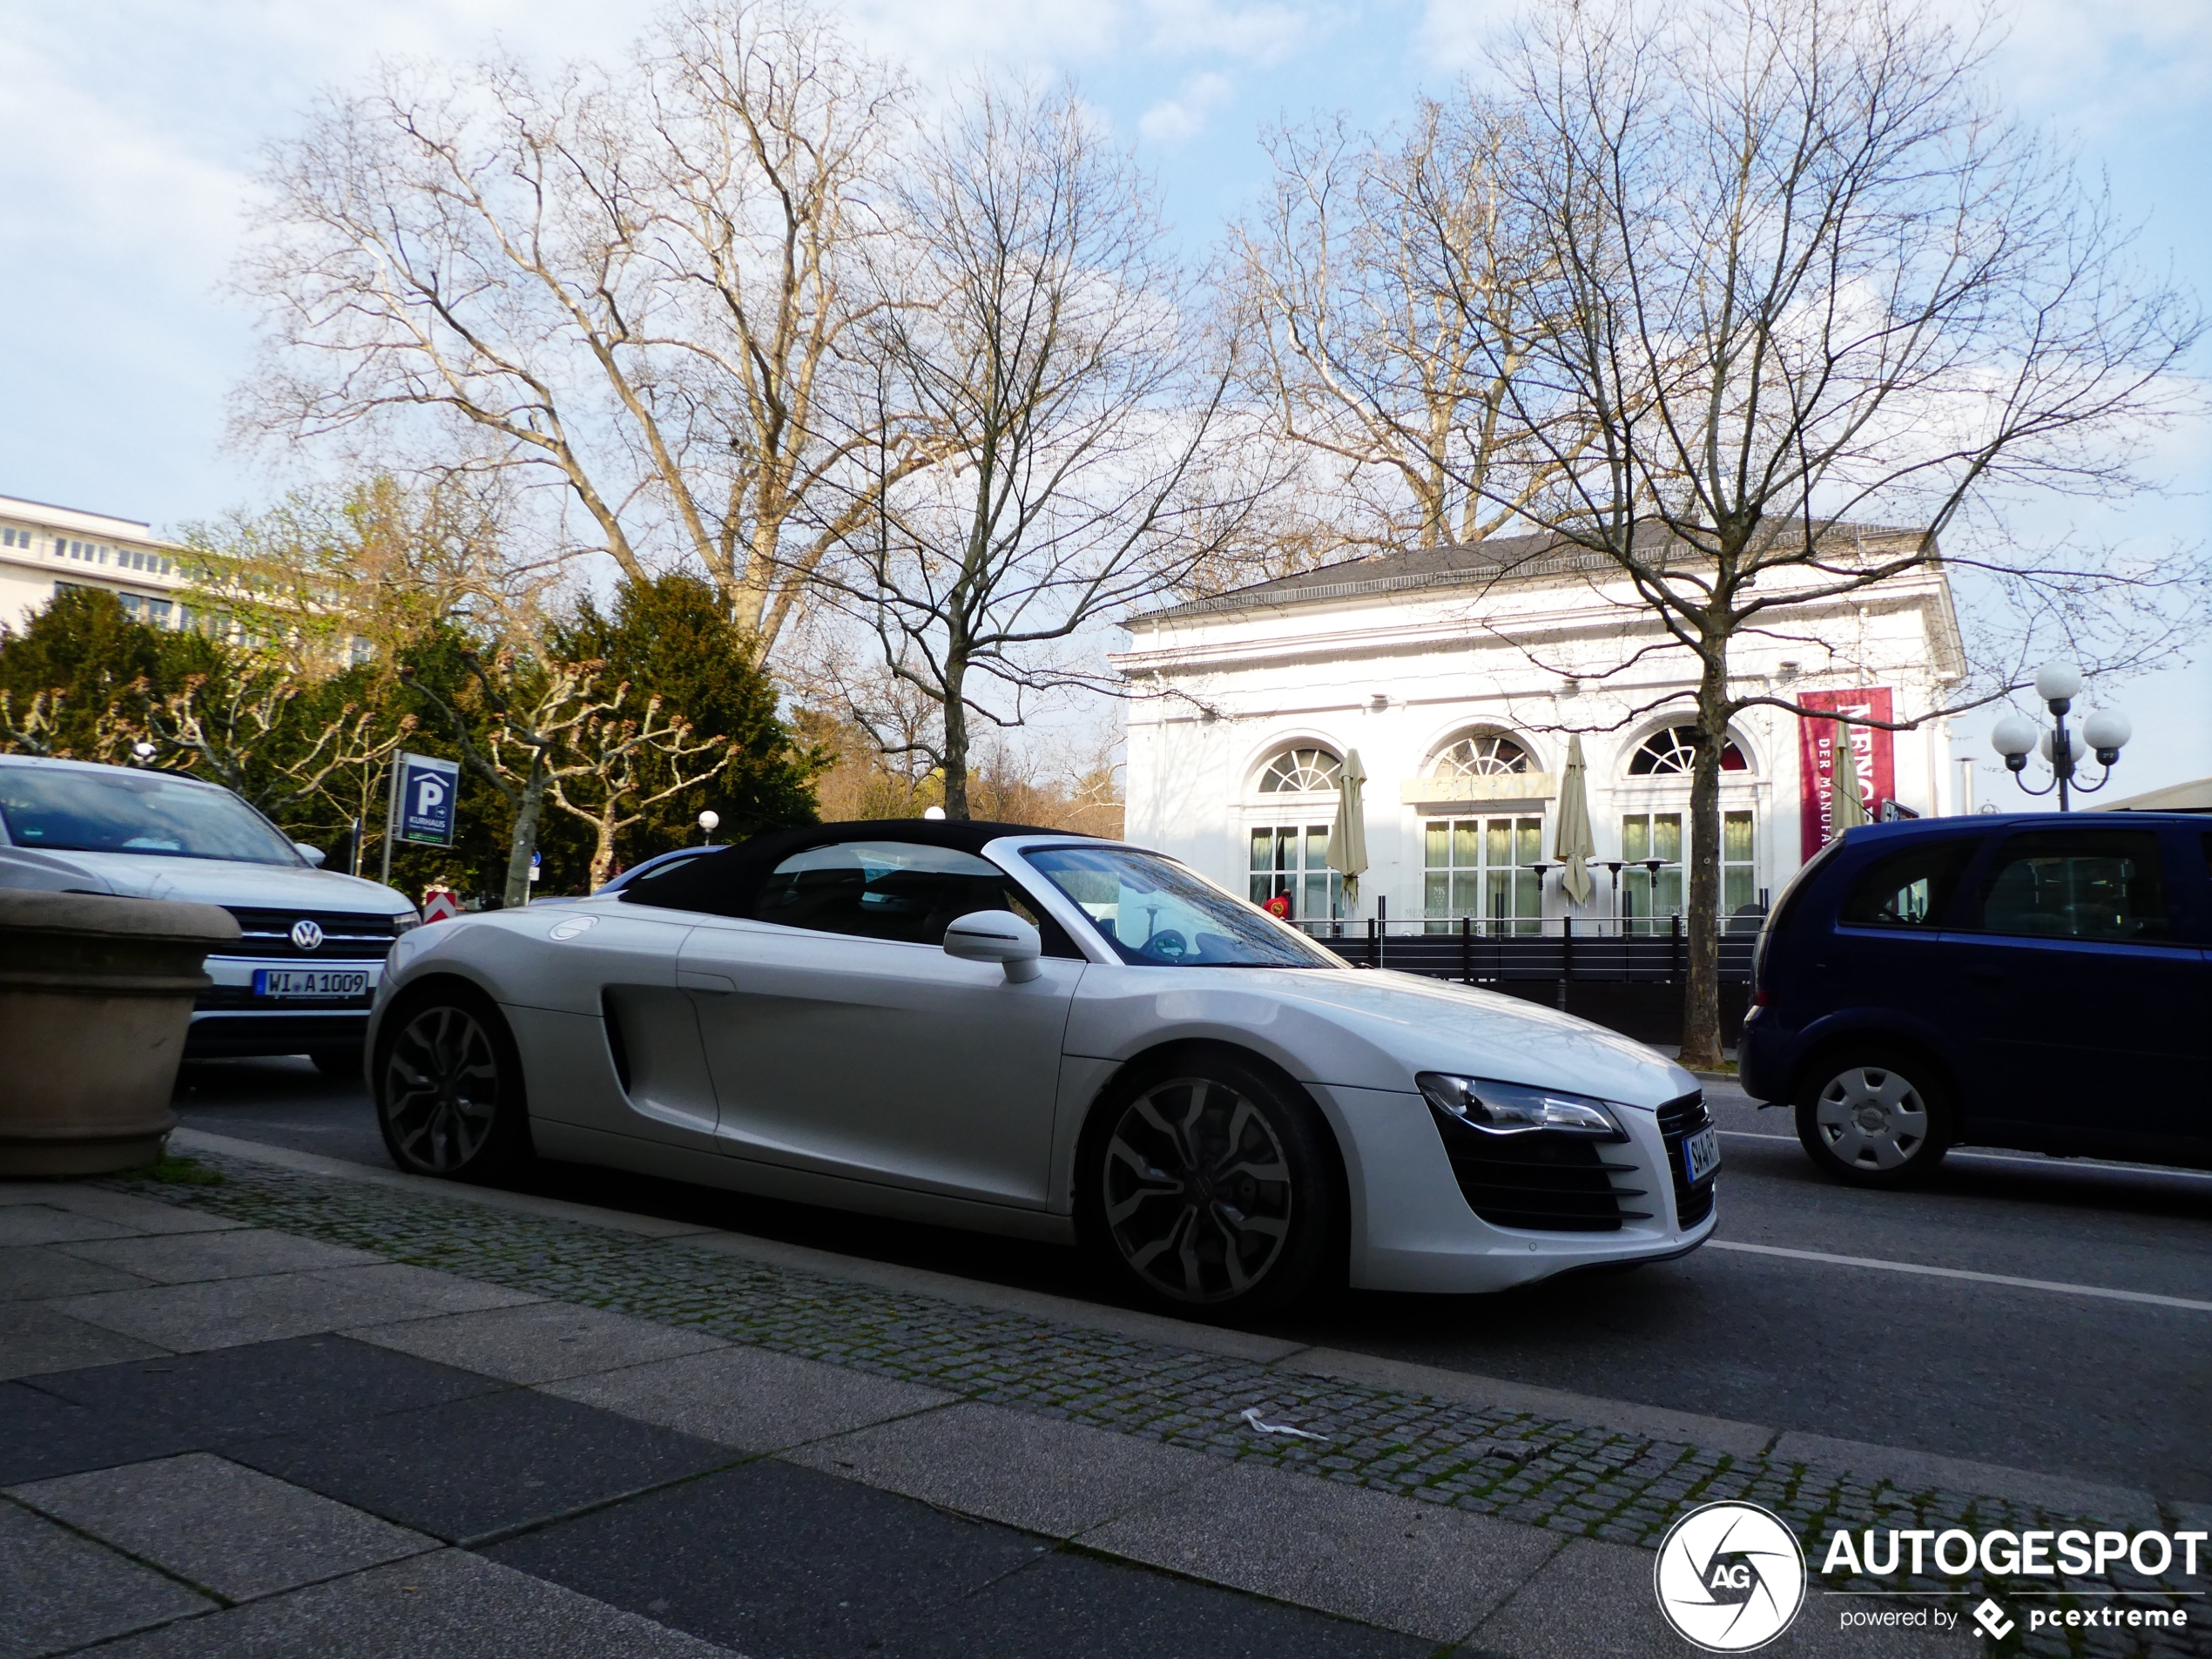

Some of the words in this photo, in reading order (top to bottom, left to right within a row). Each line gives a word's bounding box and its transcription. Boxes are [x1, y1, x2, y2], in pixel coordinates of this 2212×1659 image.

[1818, 738, 1831, 769] DER
[418, 781, 443, 816] P
[1819, 777, 1832, 848] MANUFA
[408, 815, 446, 828] KURHAUS
[269, 974, 291, 992] WI
